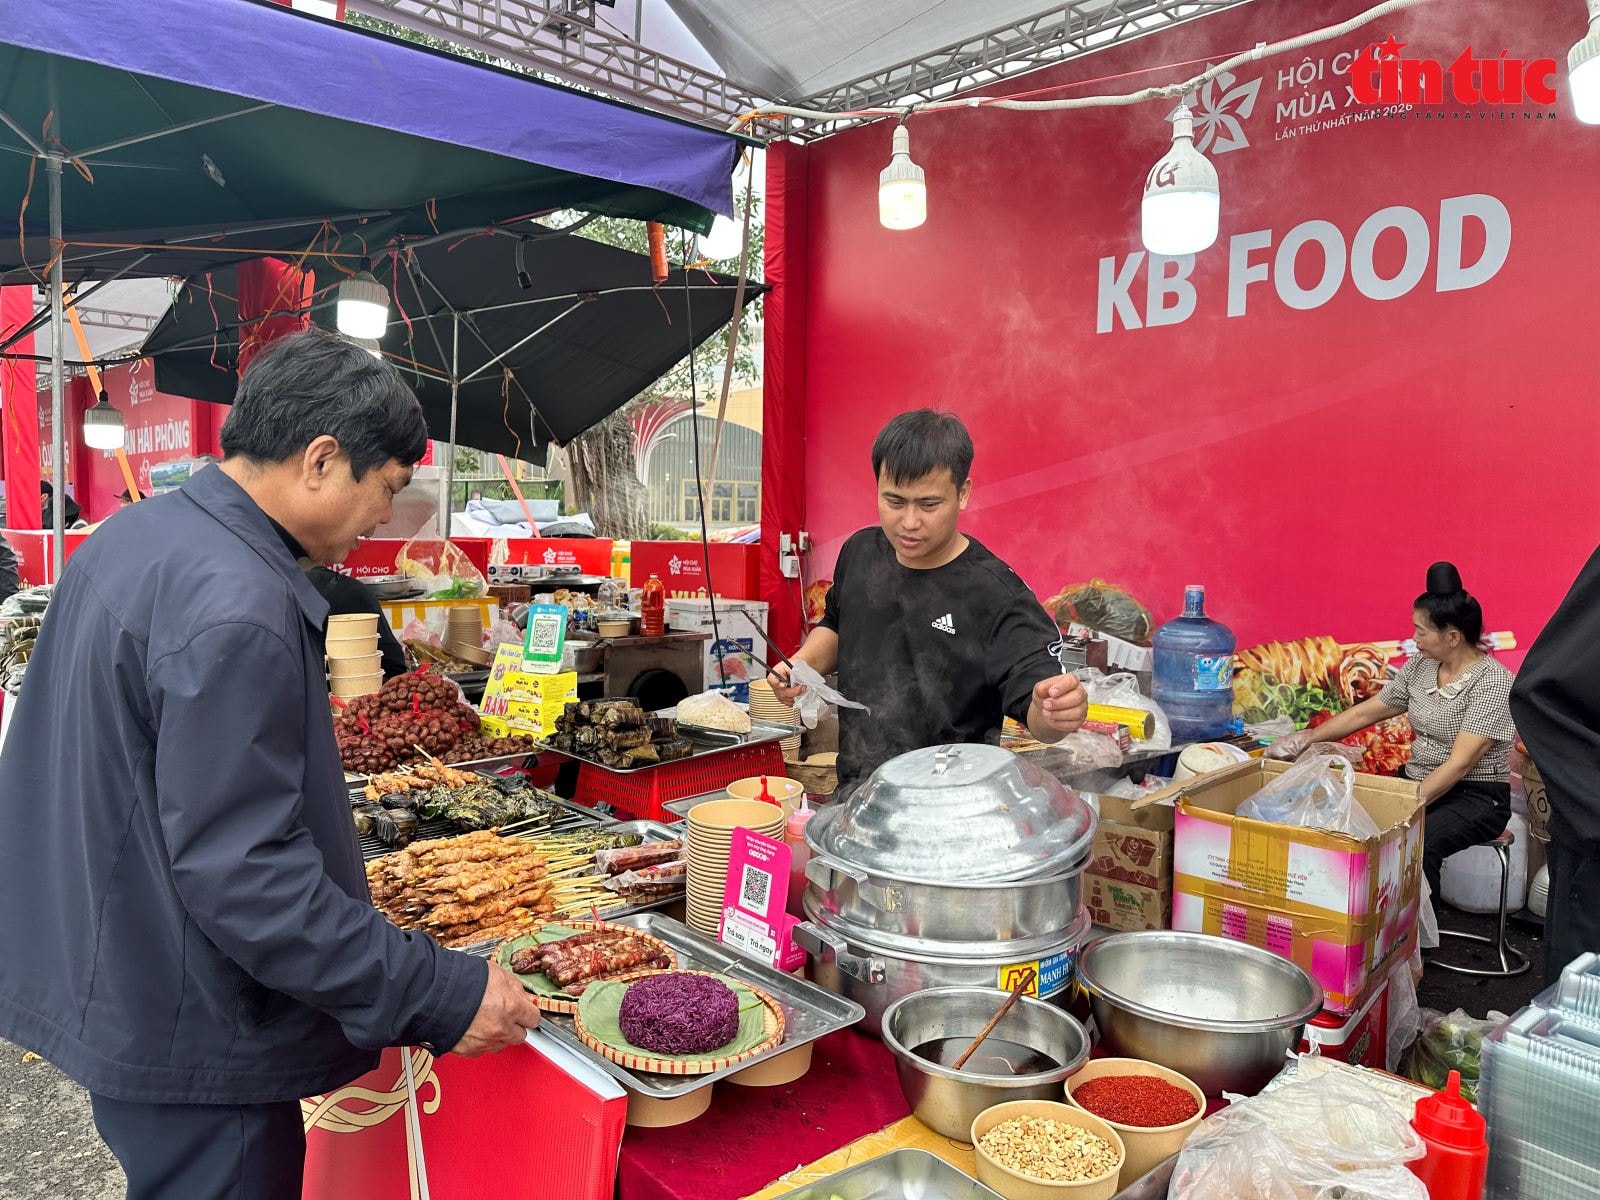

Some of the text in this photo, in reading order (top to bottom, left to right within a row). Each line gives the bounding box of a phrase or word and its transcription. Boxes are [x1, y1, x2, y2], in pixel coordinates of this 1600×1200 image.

[1277, 57, 1323, 91] HỘI
[1275, 88, 1335, 124] MÙA
[1275, 121, 1297, 141] LẦN
[1299, 119, 1321, 136] THỨ
[1382, 102, 1413, 119] 2026
[1096, 193, 1512, 334] KB FOOD
[137, 420, 153, 454] HẢI
[155, 418, 190, 452] PHÒNG
[356, 565, 390, 576] HỘI CHỢ
[931, 621, 956, 634] adidas
[726, 926, 745, 942] Trả sau
[750, 938, 759, 949] Trả
[759, 943, 773, 956] ngay
